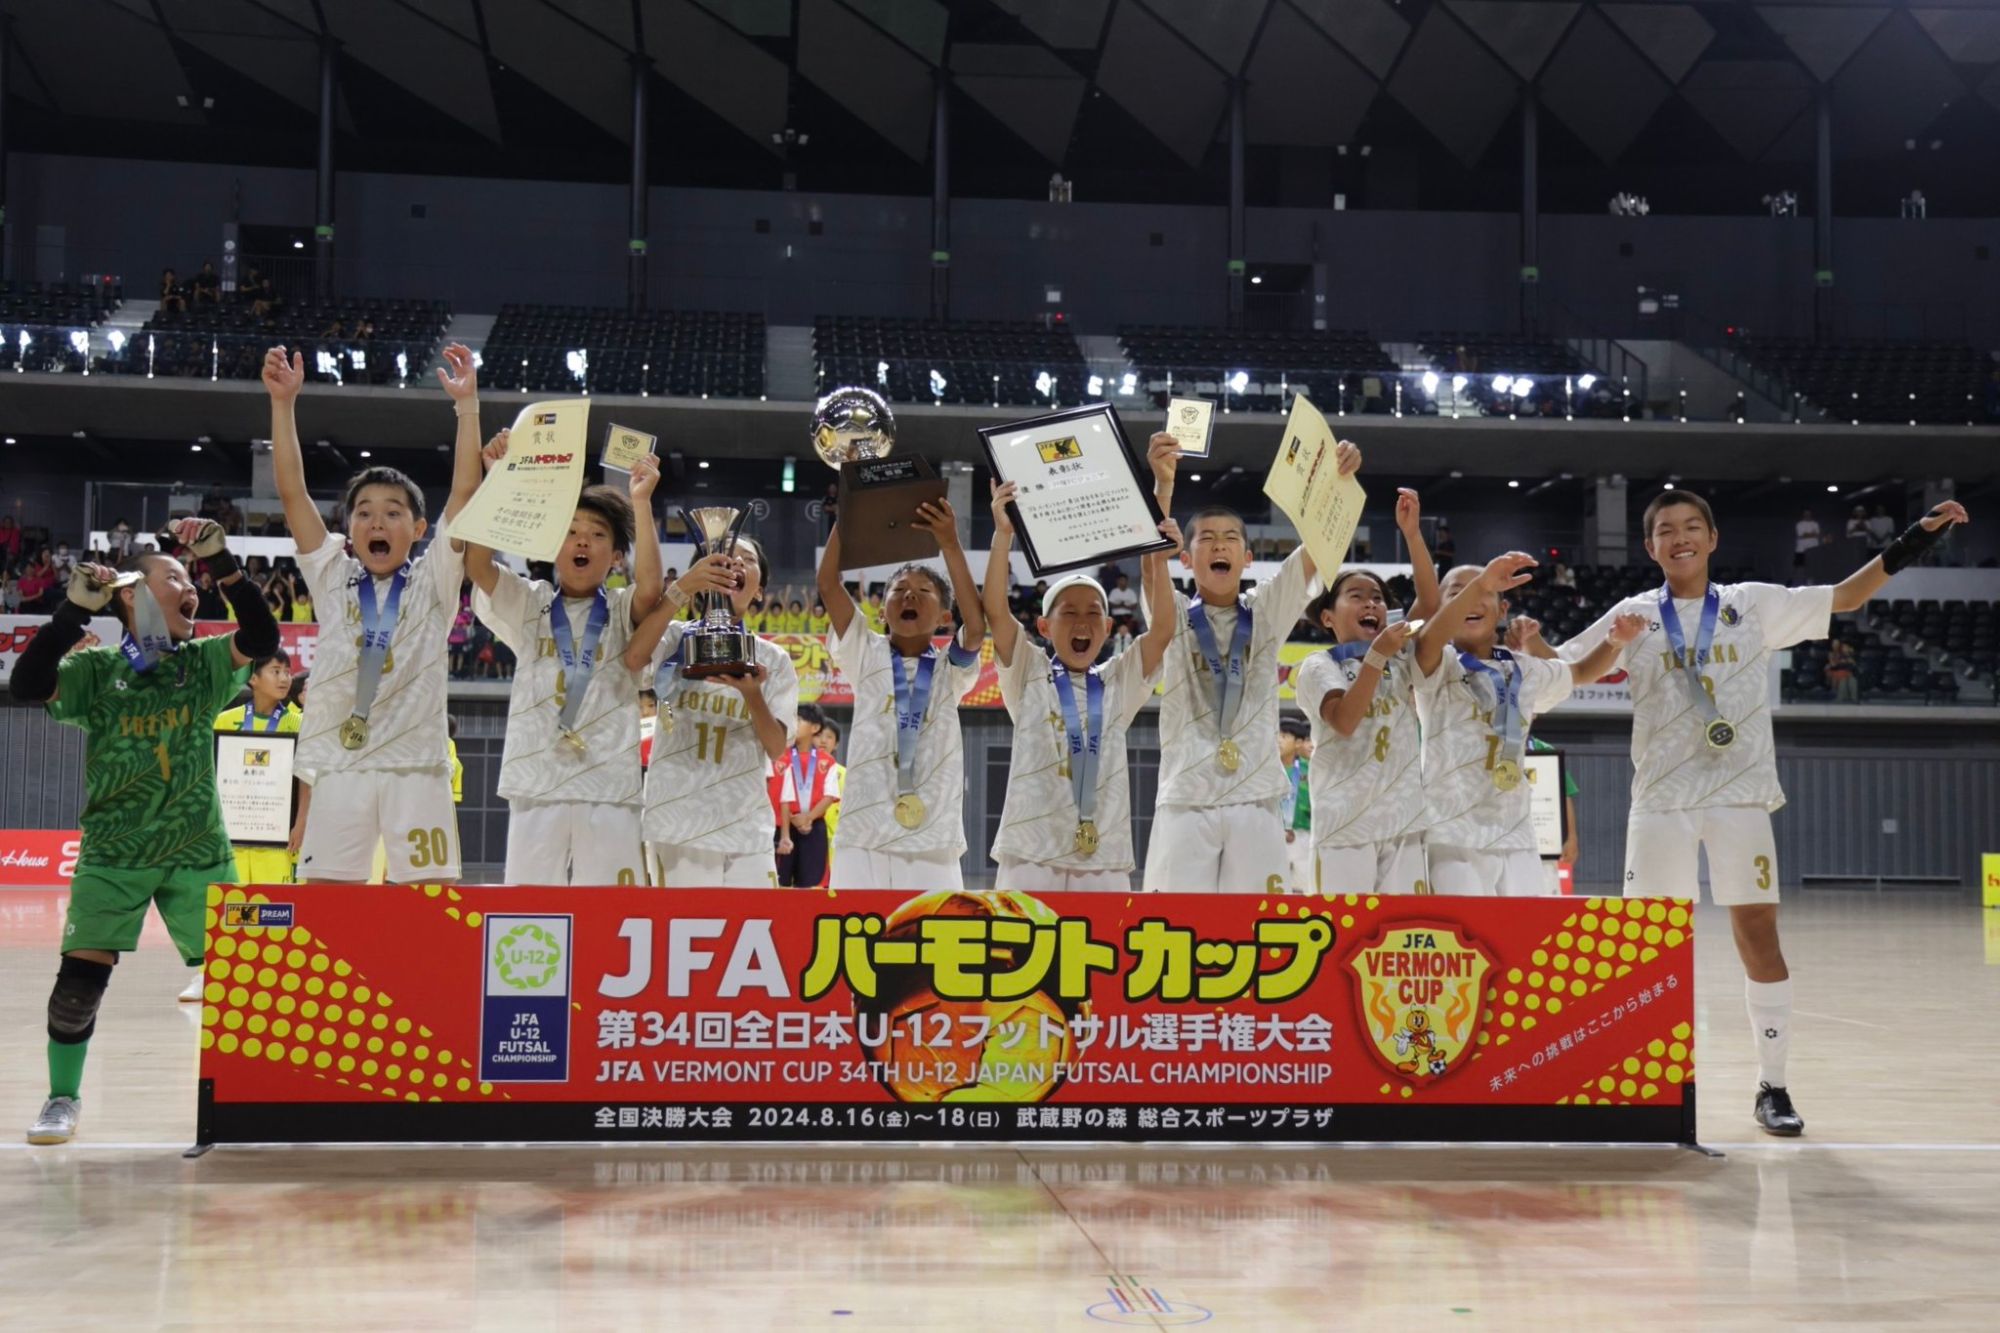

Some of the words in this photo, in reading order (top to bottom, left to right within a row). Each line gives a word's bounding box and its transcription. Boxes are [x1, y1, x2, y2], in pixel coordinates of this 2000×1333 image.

[376, 630, 390, 650] JFA
[125, 643, 141, 660] JFA
[581, 649, 593, 668] JFA
[1209, 658, 1221, 675] JFA
[910, 711, 921, 730] JFA
[694, 722, 727, 764] 11
[1088, 735, 1099, 755] JFA
[153, 742, 171, 783] 1
[408, 826, 448, 868] 30
[1753, 855, 1771, 890] 3
[261, 909, 290, 918] DREAM
[1402, 933, 1436, 949] JFA
[511, 950, 545, 964] U-12
[1365, 951, 1476, 977] VERMONT
[1397, 978, 1443, 1005] CUP
[512, 1013, 539, 1026] JFA
[510, 1027, 540, 1040] U-12
[597, 1010, 1334, 1052] 第34回全日本U-12フットサル選手権大会
[1489, 973, 1679, 1092] 未来への挑戦はここから始まる
[499, 1040, 550, 1054] FUTSAL
[492, 1054, 557, 1064] CHAMPIONSHIP
[595, 1061, 645, 1082] JFA
[653, 1061, 776, 1082] VERMONT
[782, 1061, 833, 1083] CUP
[839, 1061, 899, 1083] 34TH
[906, 1061, 958, 1083] U-12
[964, 1062, 1045, 1084] JAPAN
[1052, 1062, 1143, 1084] FUTSAL
[1150, 1062, 1333, 1084] CHAMPIONSHIP
[594, 1107, 733, 1128] 全国決勝大会
[1016, 1107, 1128, 1129] 武蔵野の森
[1137, 1107, 1334, 1129] 総合スポーツプラザ
